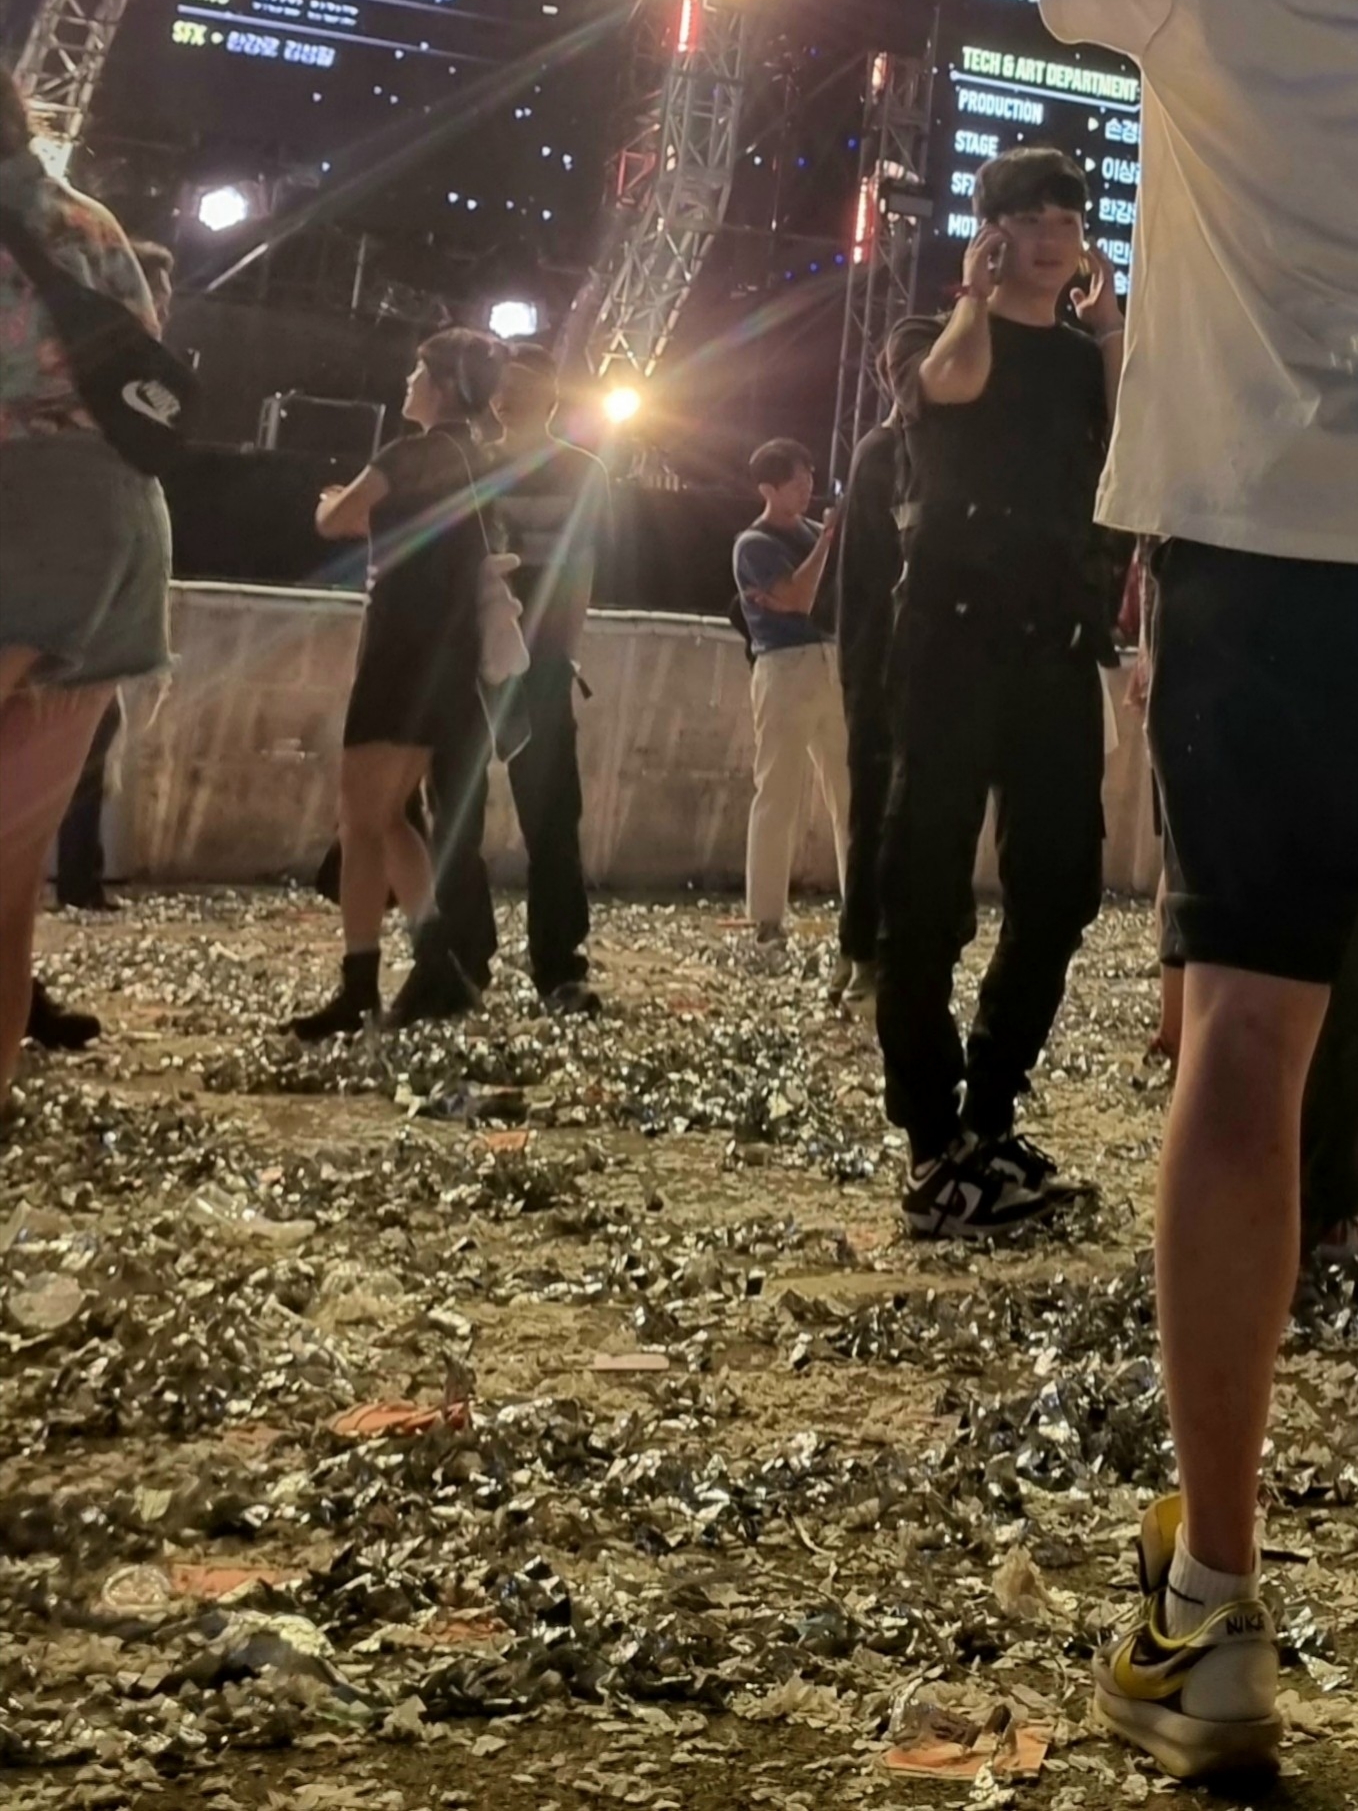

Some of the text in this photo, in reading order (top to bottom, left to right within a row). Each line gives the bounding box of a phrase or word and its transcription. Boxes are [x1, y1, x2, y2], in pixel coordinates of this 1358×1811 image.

[173, 21, 207, 45] SFX
[962, 46, 1002, 78] TECH
[1015, 57, 1046, 85] ART
[1045, 62, 1140, 103] DEPARTMENT
[958, 90, 1140, 145] PRODUCTION 손경
[954, 130, 1140, 185] STAGE 이상
[1099, 197, 1136, 225] 한강
[1226, 1613, 1265, 1636] NIKE
